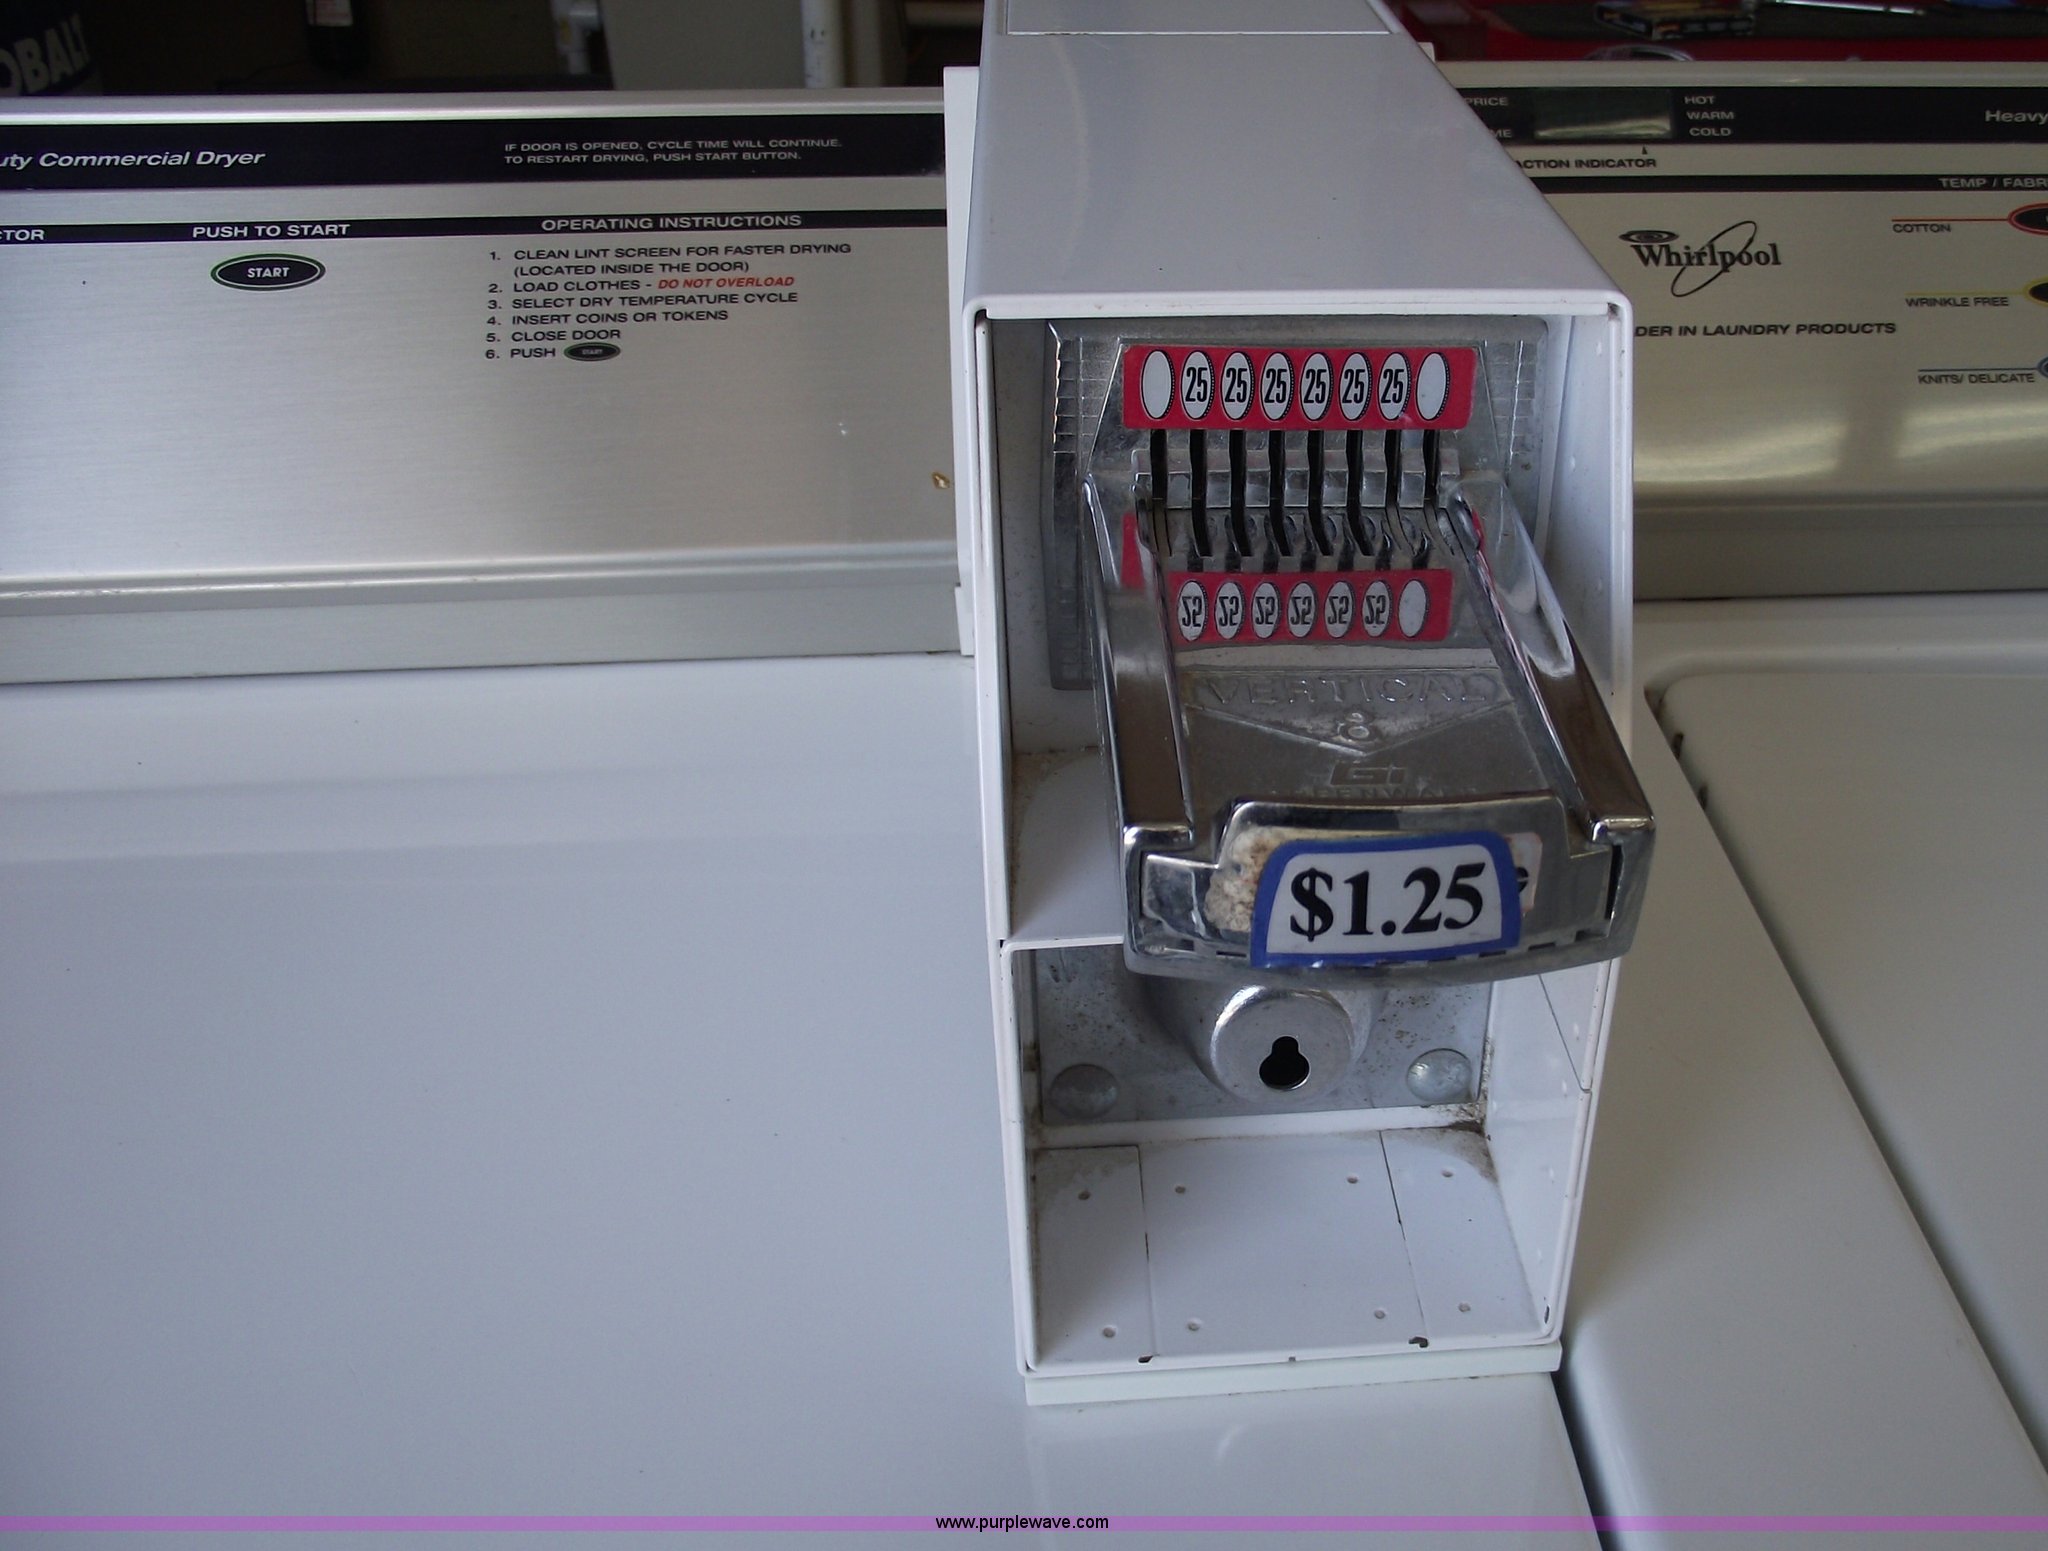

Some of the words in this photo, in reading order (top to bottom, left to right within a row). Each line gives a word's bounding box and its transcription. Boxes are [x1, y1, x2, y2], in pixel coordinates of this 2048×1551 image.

[1684, 95, 1715, 105] HOT
[1686, 111, 1735, 120] WARM
[1985, 109, 2048, 125] Heavy
[1689, 127, 1732, 137] COLD
[505, 143, 517, 152] IF
[521, 143, 561, 152] DOOR
[565, 142, 578, 151] IS
[582, 141, 643, 152] OPENED,
[647, 140, 692, 150] CYCLE
[696, 139, 729, 149] TIME
[732, 139, 764, 149] WILL
[768, 138, 842, 149] CONTINUE.
[39, 151, 190, 167] Commercial
[196, 151, 266, 168] Dryer
[504, 155, 523, 165] TO
[527, 154, 589, 164] RESTART
[592, 153, 648, 164] DRYING,
[653, 152, 691, 162] PUSH
[695, 151, 738, 162] START
[742, 151, 801, 161] BUTTON.
[1575, 157, 1657, 169] INDICATOR
[1938, 177, 1987, 188] TEMP
[541, 217, 653, 231] OPERATING
[659, 214, 802, 229] INSTRUCTIONS
[1892, 222, 1951, 233] COTTON
[192, 226, 249, 238] PUSH
[254, 225, 282, 237] TO
[287, 224, 351, 237] START
[490, 251, 501, 261] 1.
[514, 249, 570, 260] CLEAN
[574, 248, 610, 259] LINT
[614, 247, 681, 258] SCREEN
[686, 246, 719, 257] FOR
[724, 245, 785, 256] FASTER
[790, 243, 852, 254] DRYING
[1630, 243, 1782, 273] Whirlpool
[247, 266, 290, 278] START
[514, 264, 596, 278] (LOCATED
[601, 263, 654, 275] INSIDE
[659, 262, 691, 273] THE
[696, 261, 750, 274] DOOR)
[488, 283, 503, 293] 2.
[513, 281, 559, 293] LOAD
[564, 280, 641, 292] CLOTHES
[658, 279, 679, 290] DO
[683, 278, 713, 289] NOT
[716, 276, 795, 288] OVERLOAD
[487, 299, 502, 310] 3.
[512, 298, 575, 309] SELECT
[579, 296, 614, 308] DRY
[618, 293, 740, 307] TEMPERATURE
[744, 292, 798, 304] CYCLE
[1905, 297, 1970, 308] WRINKLE
[1974, 296, 2010, 307] FREE
[486, 316, 502, 326] 4.
[512, 314, 571, 325] INSERT
[575, 312, 628, 324] COINS
[633, 311, 657, 323] OR
[662, 310, 729, 322] TOKENS
[486, 332, 501, 343] 5.
[511, 330, 567, 342] CLOSE
[572, 329, 621, 341] DOOR
[1678, 324, 1697, 336] IN
[1703, 323, 1790, 336] LAUNDRY
[1795, 322, 1897, 335] PRODUCTS
[485, 349, 500, 360] 6.
[510, 348, 556, 359] PUSH
[1185, 366, 1208, 403] 25
[1225, 367, 1248, 403] 25
[1264, 368, 1287, 404] 25
[1303, 368, 1327, 404] 25
[1342, 368, 1365, 404] 25
[1380, 368, 1405, 404] 25
[1968, 372, 2036, 384] DELICATE
[1289, 861, 1487, 942] $1.25
